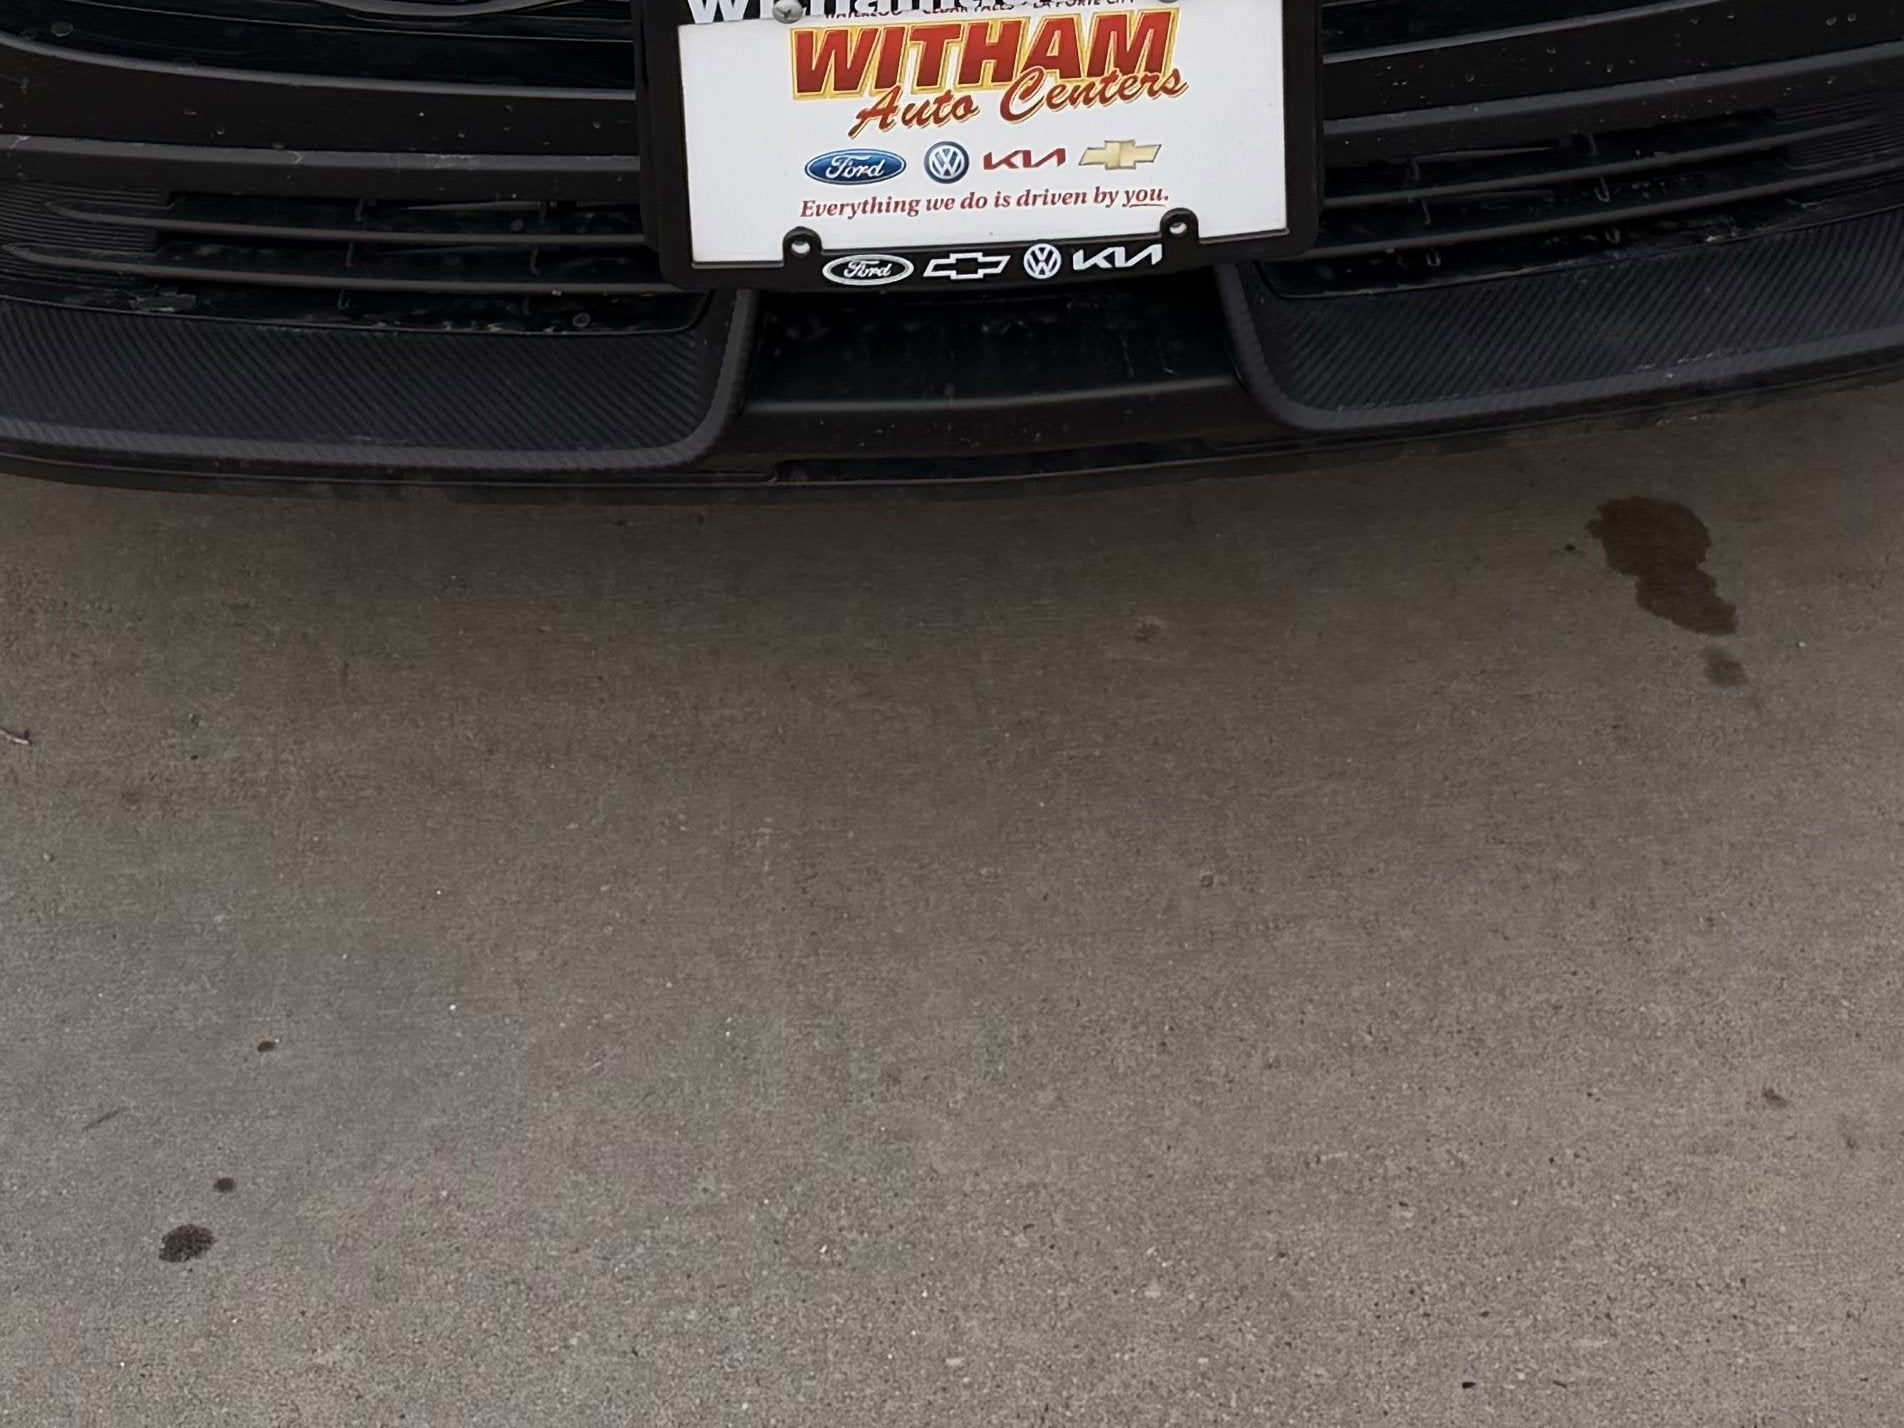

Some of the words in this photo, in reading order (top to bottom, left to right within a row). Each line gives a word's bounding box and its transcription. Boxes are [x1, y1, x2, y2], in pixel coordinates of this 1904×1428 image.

[790, 7, 1180, 100] WITHAM
[847, 84, 980, 139] Auto
[999, 66, 1189, 124] Centers
[825, 151, 886, 180] Ford
[983, 148, 1066, 170] KIA
[800, 195, 921, 220] Everything
[925, 197, 955, 212] we
[960, 191, 988, 210] do
[994, 190, 1011, 208] is
[1016, 187, 1087, 208] driven
[1094, 185, 1119, 208] by
[1122, 187, 1169, 208] you.
[843, 260, 892, 279] Ford
[1072, 244, 1163, 271] KIA
